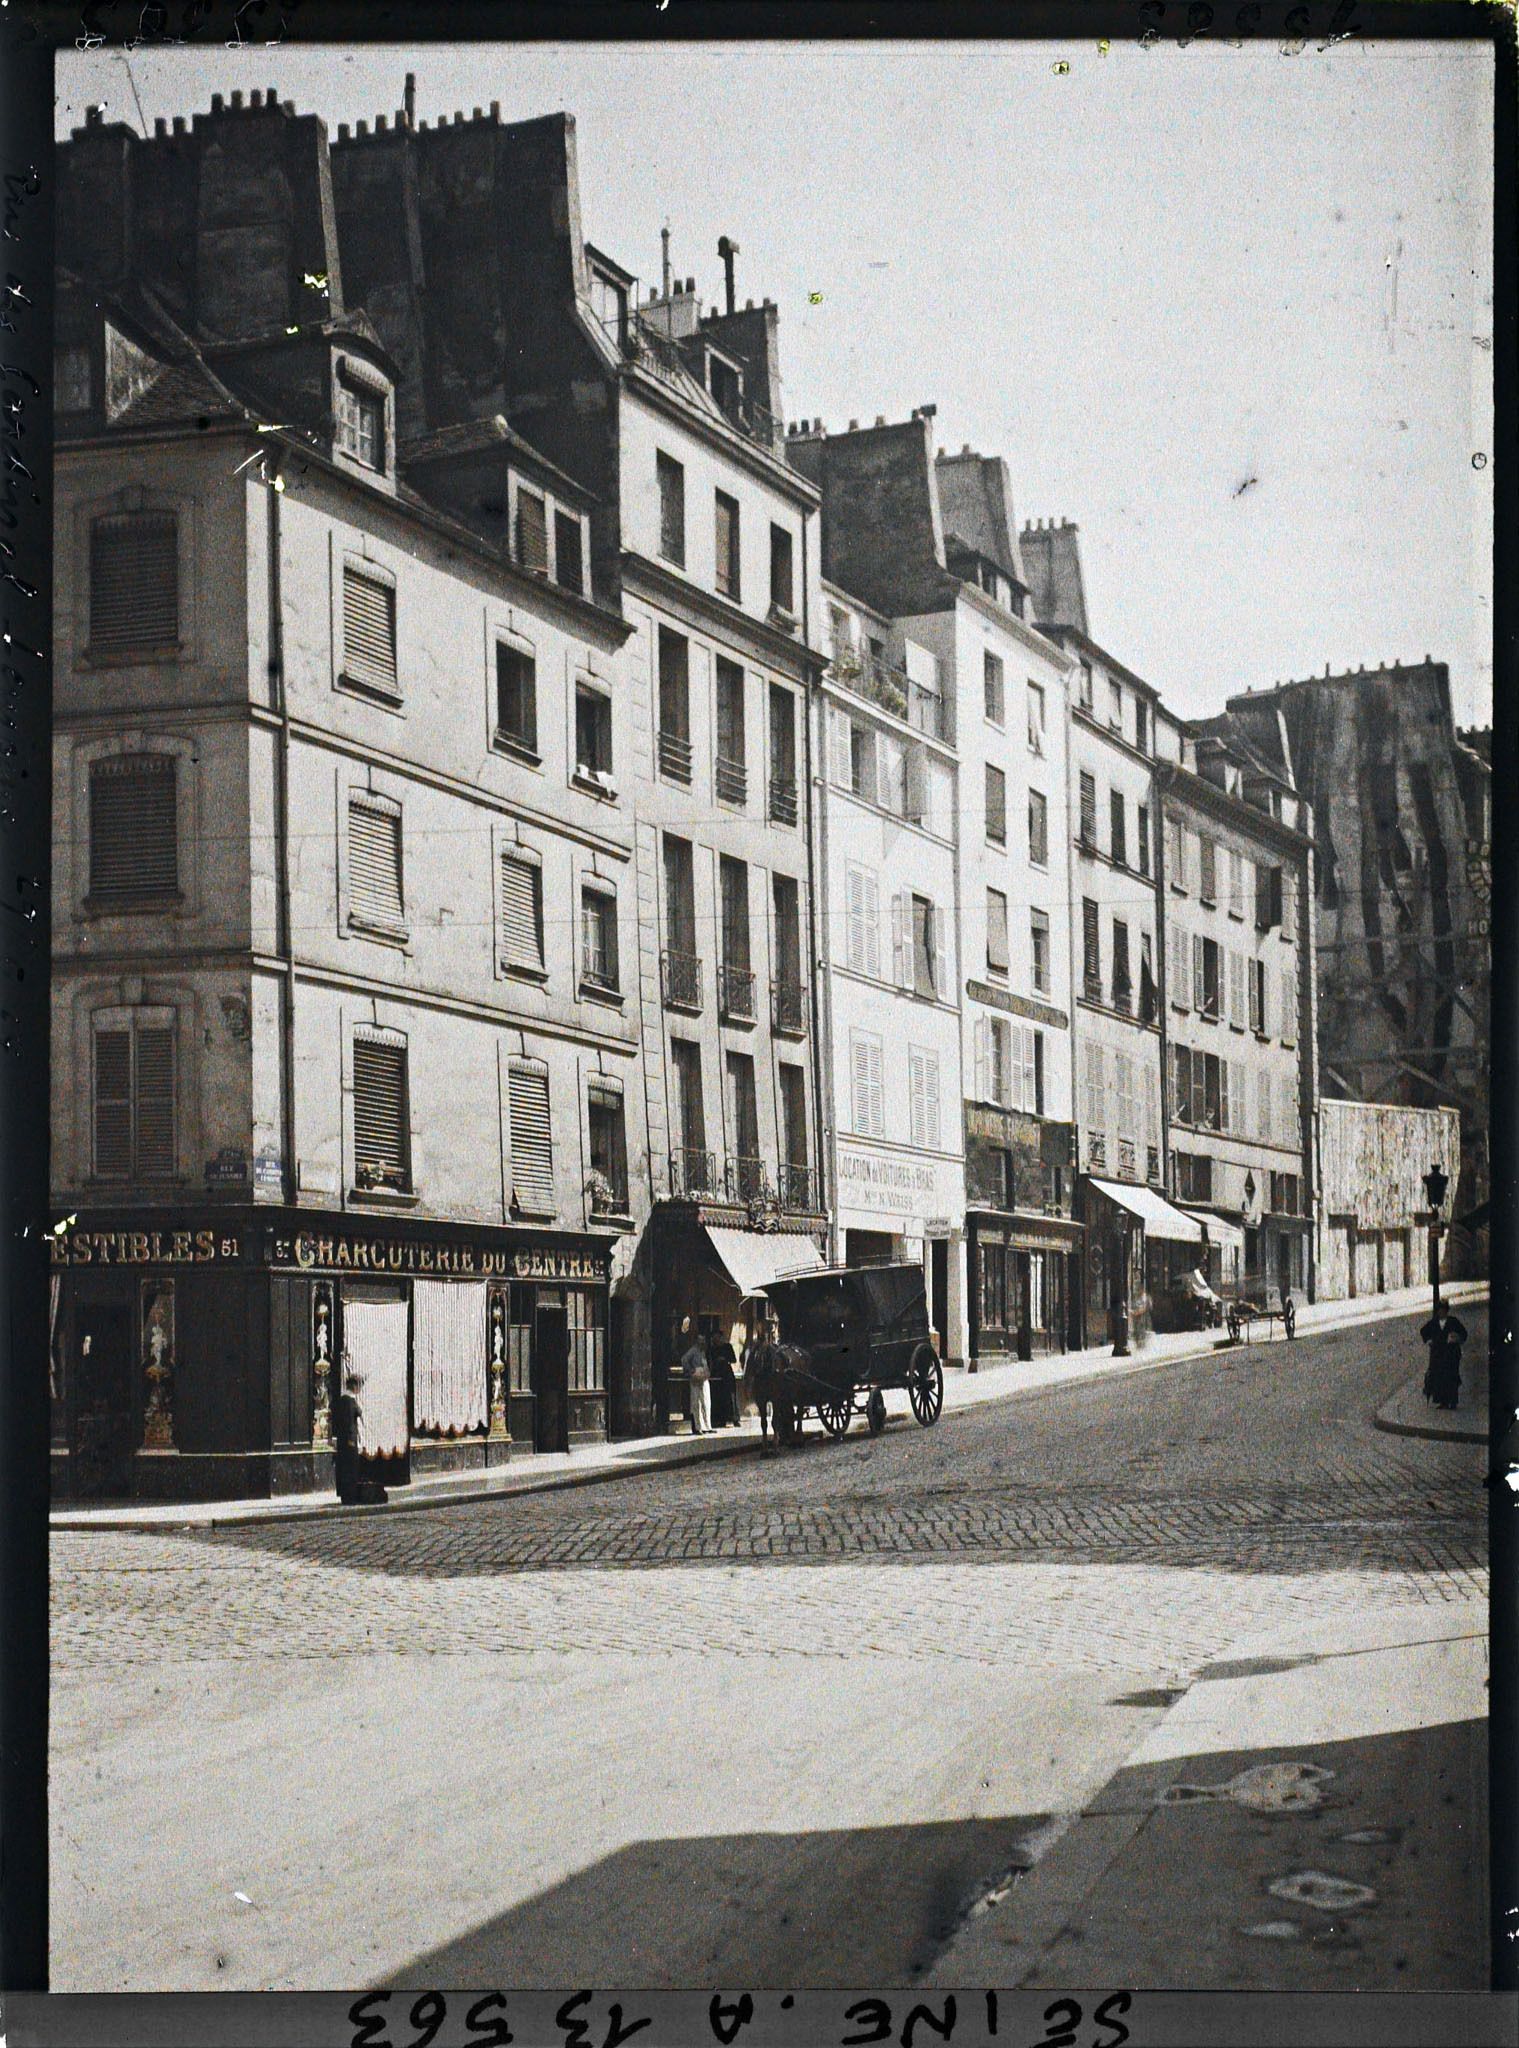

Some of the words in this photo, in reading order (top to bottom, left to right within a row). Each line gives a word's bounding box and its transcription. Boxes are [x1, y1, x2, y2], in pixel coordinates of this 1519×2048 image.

[221, 1238, 239, 1257] 51
[294, 1231, 475, 1273] CHARCUTERIE
[481, 1248, 506, 1274] DU
[513, 1246, 594, 1278] CENTRE
